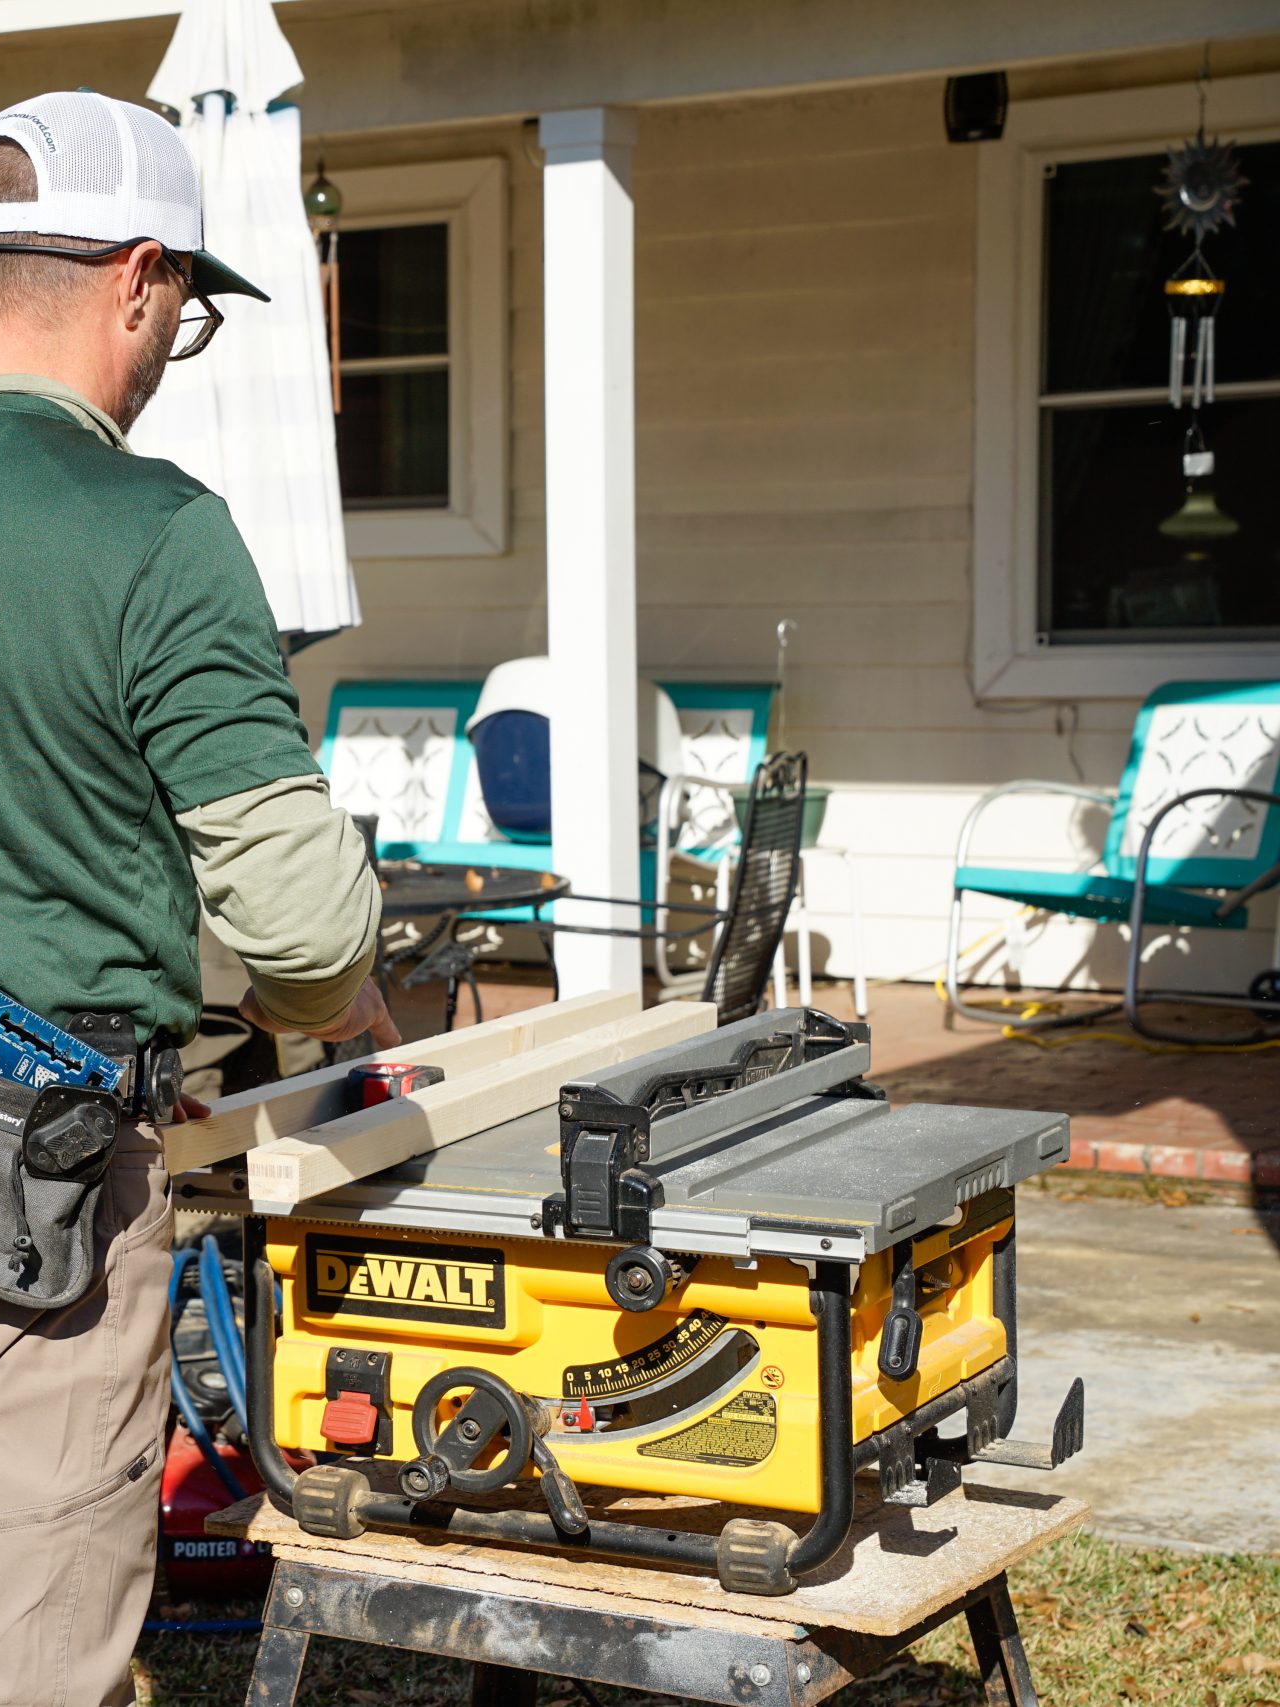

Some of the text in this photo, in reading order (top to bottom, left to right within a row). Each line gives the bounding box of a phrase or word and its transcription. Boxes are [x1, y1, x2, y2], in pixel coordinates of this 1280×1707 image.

[566, 1371, 574, 1382] 0
[583, 1371, 592, 1381] 5
[597, 1368, 612, 1379] 10
[615, 1363, 629, 1374] 15
[631, 1357, 646, 1370] 20
[647, 1349, 662, 1362] 25
[662, 1340, 677, 1353] 30
[676, 1329, 690, 1344] 35
[689, 1318, 702, 1333] 40
[174, 1541, 237, 1558] PORTER
